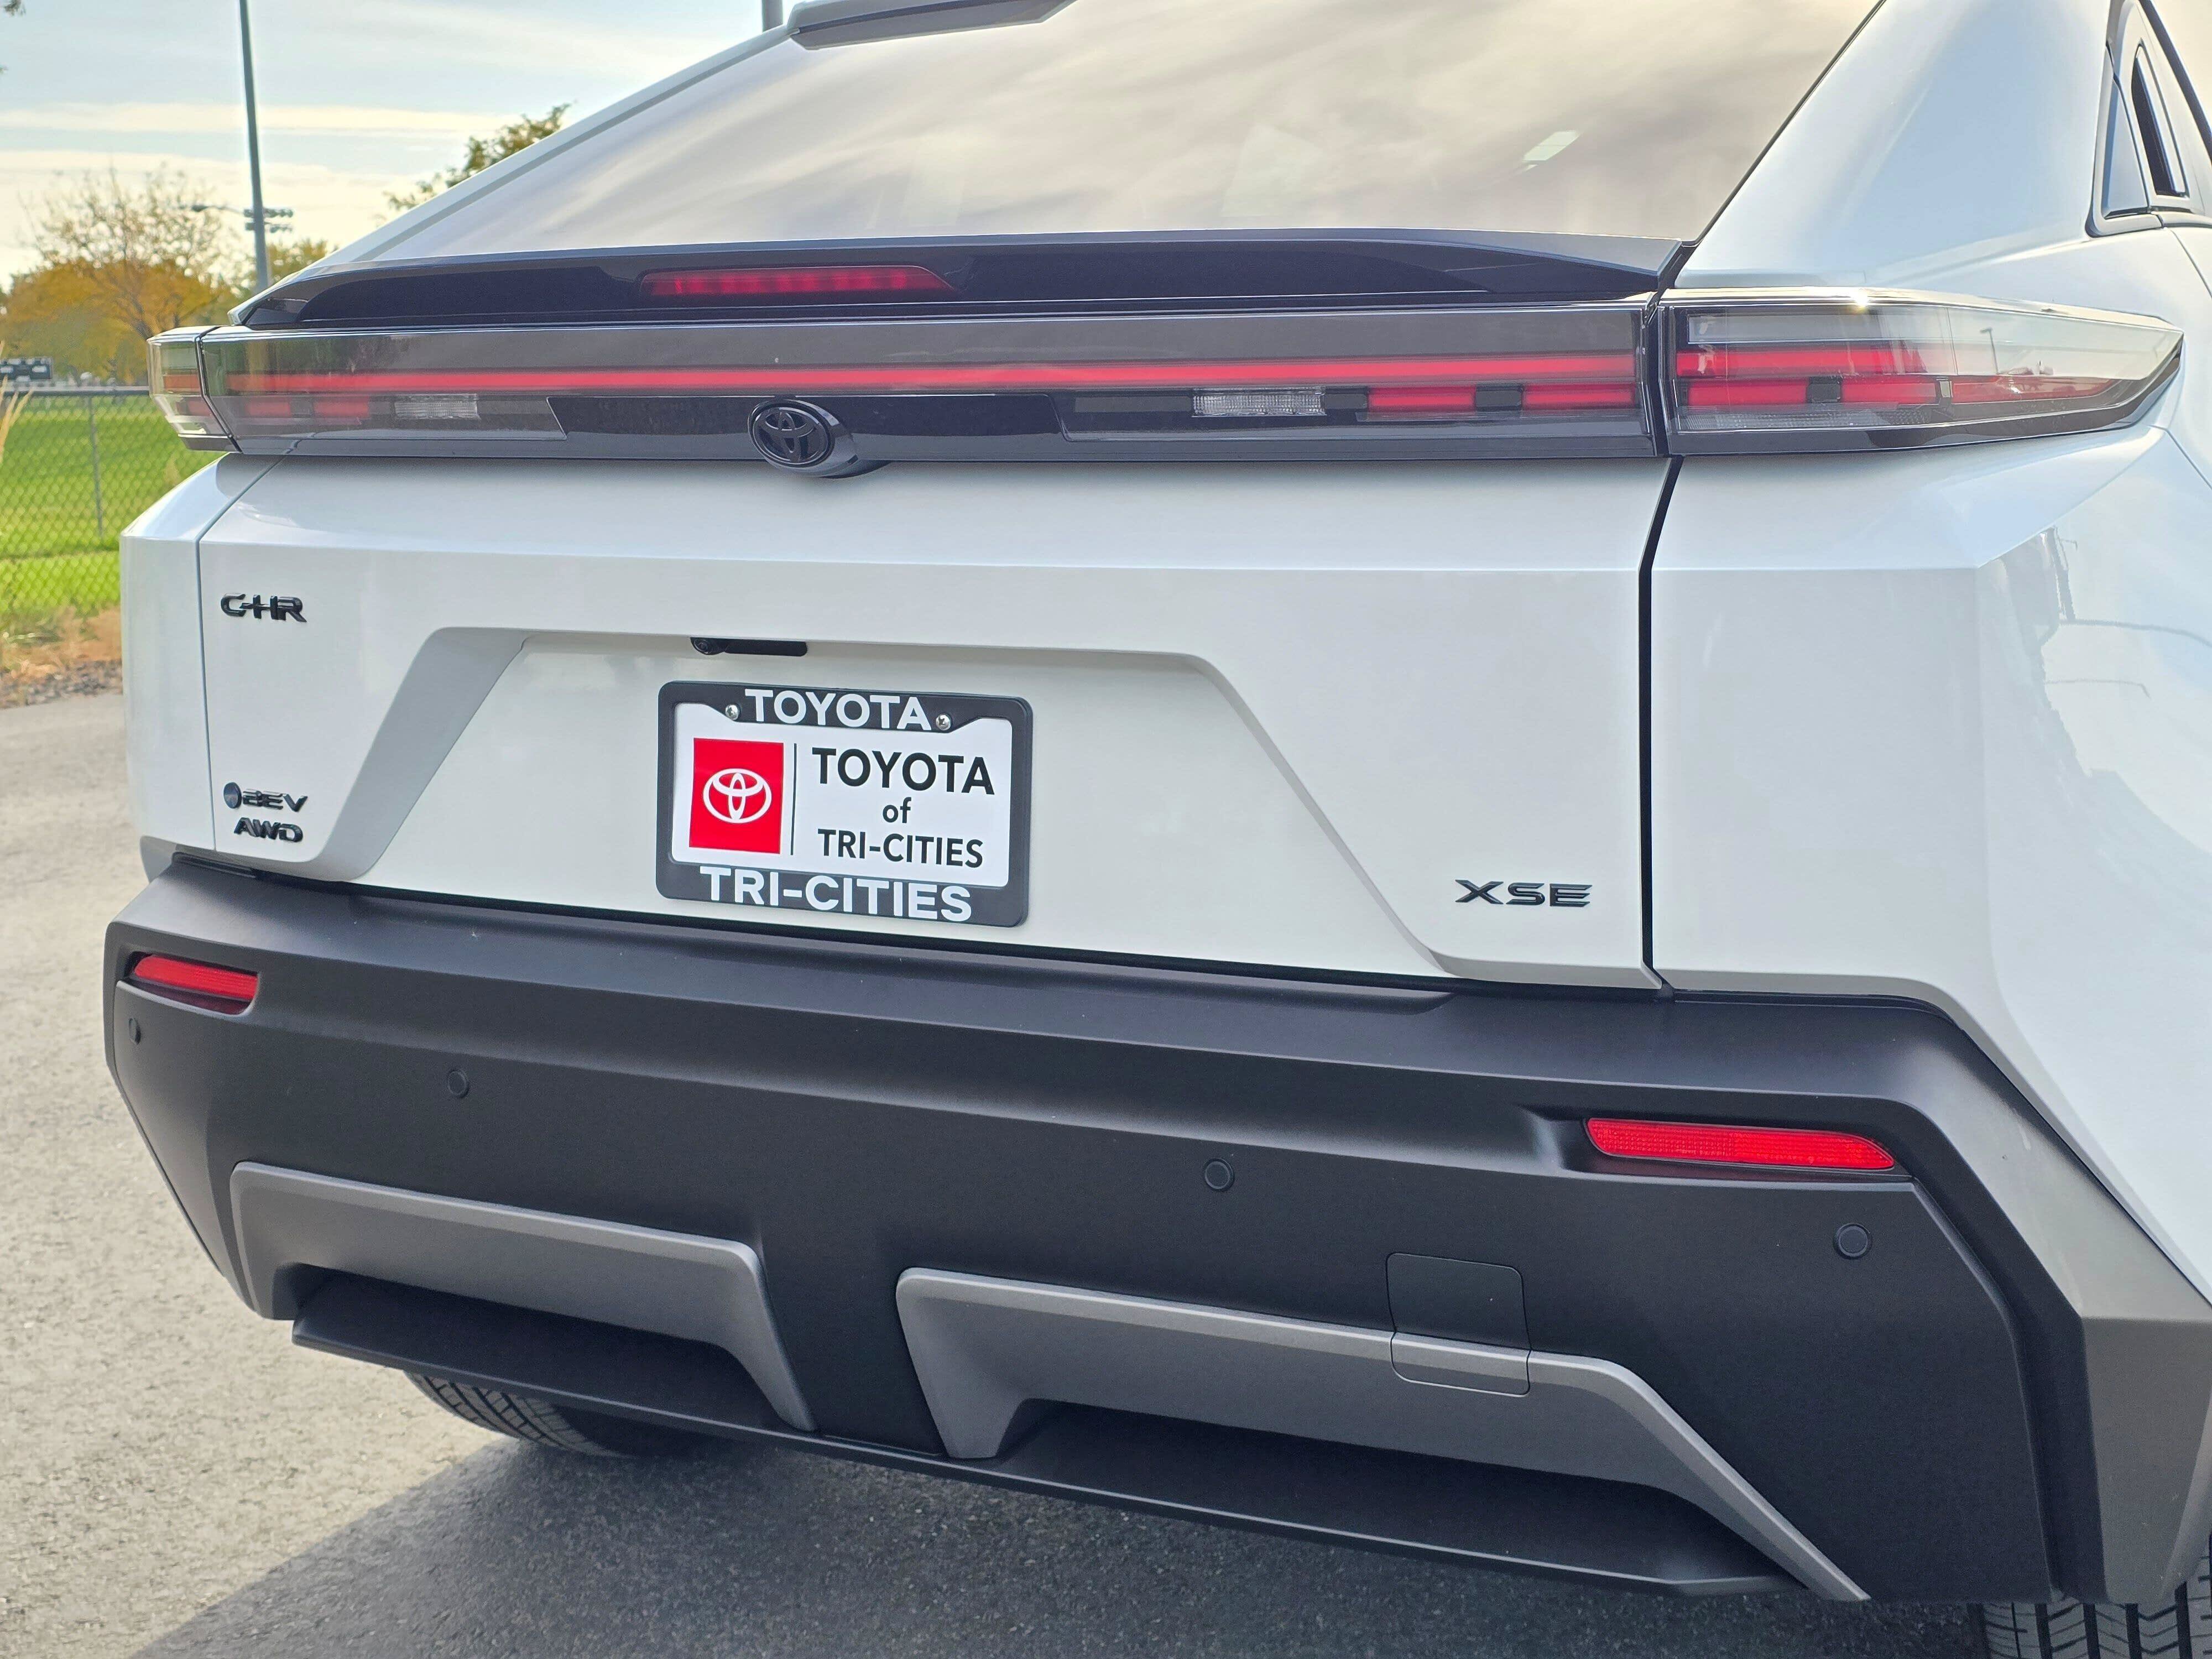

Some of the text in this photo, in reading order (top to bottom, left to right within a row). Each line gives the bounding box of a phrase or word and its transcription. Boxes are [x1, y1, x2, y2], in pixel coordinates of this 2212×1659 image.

[745, 688, 932, 731] TOYOTA
[812, 747, 995, 795] TOYOTA
[242, 788, 308, 812] BEV
[883, 797, 911, 824] of
[233, 817, 303, 843] AWD
[817, 829, 983, 868] TRI-CITIES
[700, 865, 972, 922] TRI-CITIES
[1455, 879, 1593, 907] XSE
